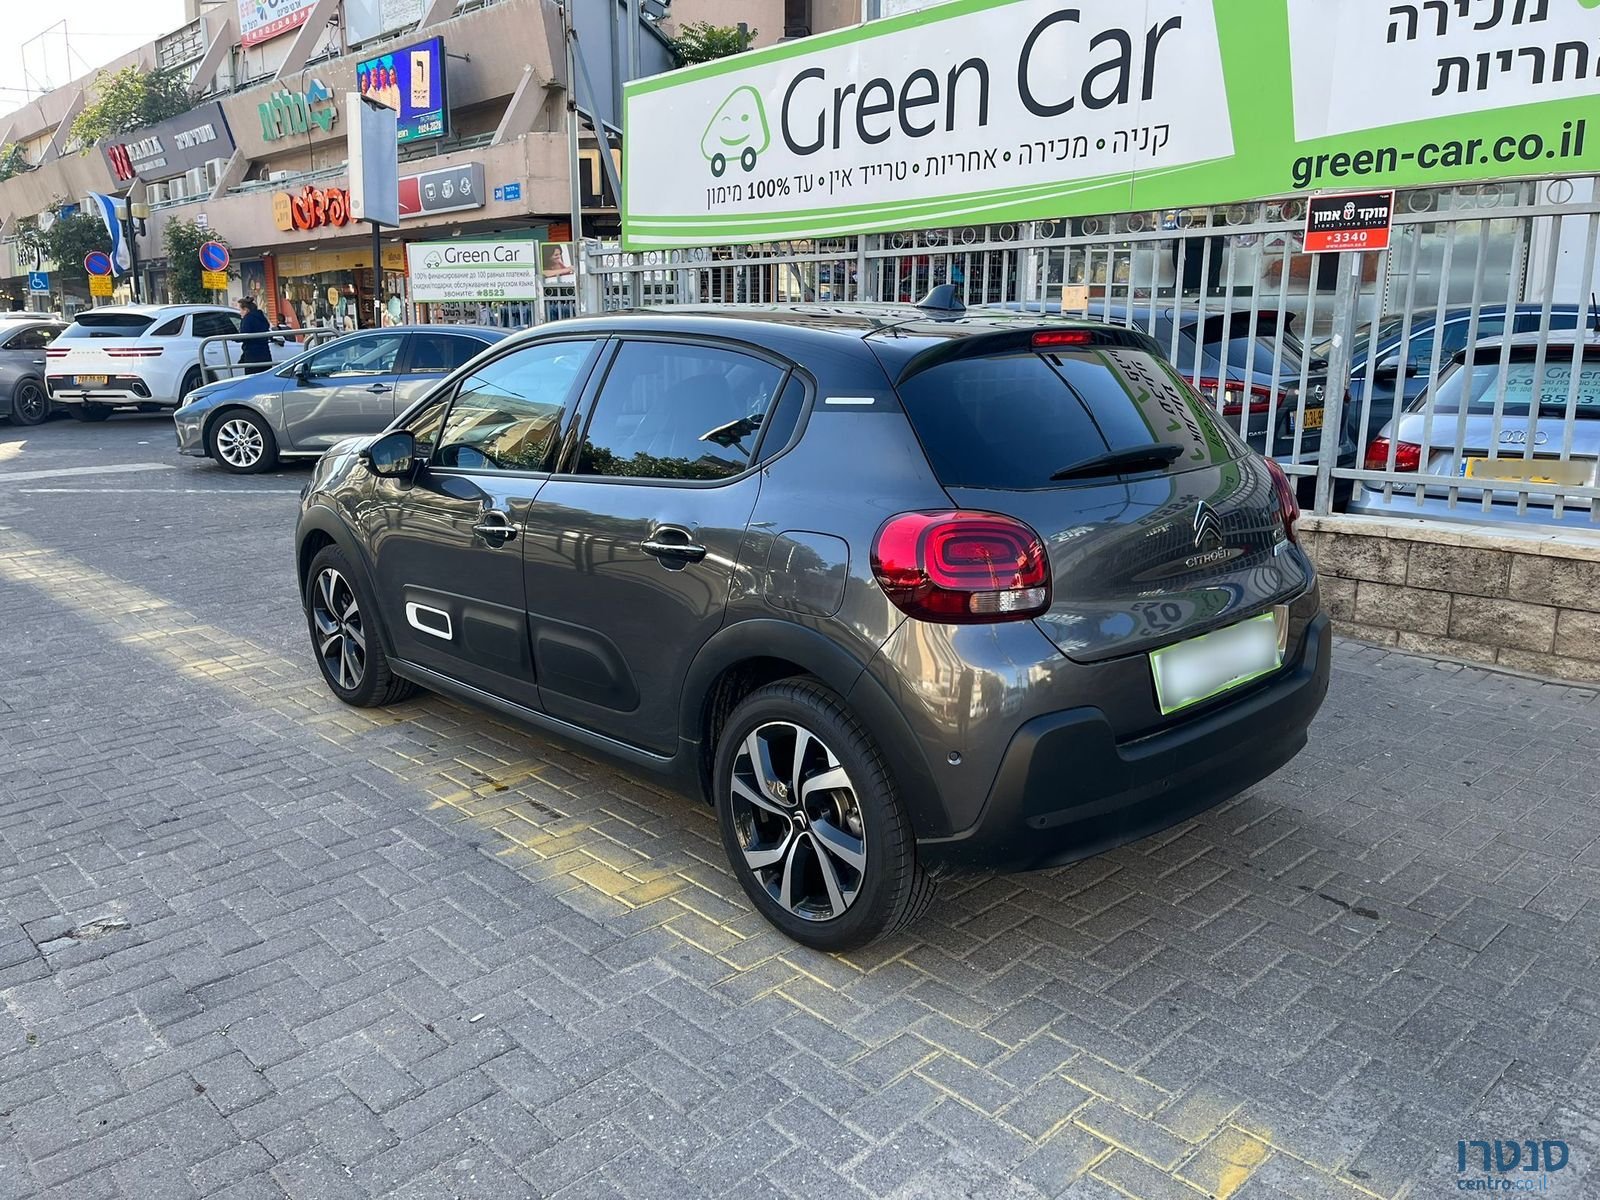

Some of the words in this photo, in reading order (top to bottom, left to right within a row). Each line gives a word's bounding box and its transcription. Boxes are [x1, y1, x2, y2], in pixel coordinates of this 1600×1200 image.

[1387, 0, 1548, 43] מכירה
[1432, 37, 1600, 96] חריות
[781, 57, 989, 156] Green
[1017, 9, 1182, 117] Car
[1019, 136, 1088, 165] מכירה
[1113, 124, 1169, 156] קניה
[924, 148, 997, 177] אחריות
[1292, 120, 1586, 188] green-car.co.il
[794, 174, 813, 193] עד
[829, 168, 853, 195] אין
[859, 160, 907, 184] טרייד
[706, 184, 742, 210] מימון
[748, 177, 790, 200] 100%
[1314, 210, 1341, 224] אמון
[1357, 207, 1388, 221] מוקד
[445, 247, 490, 263] Green
[494, 246, 520, 262] Car
[444, 290, 475, 298] звоните:
[1185, 546, 1231, 568] CITROËN
